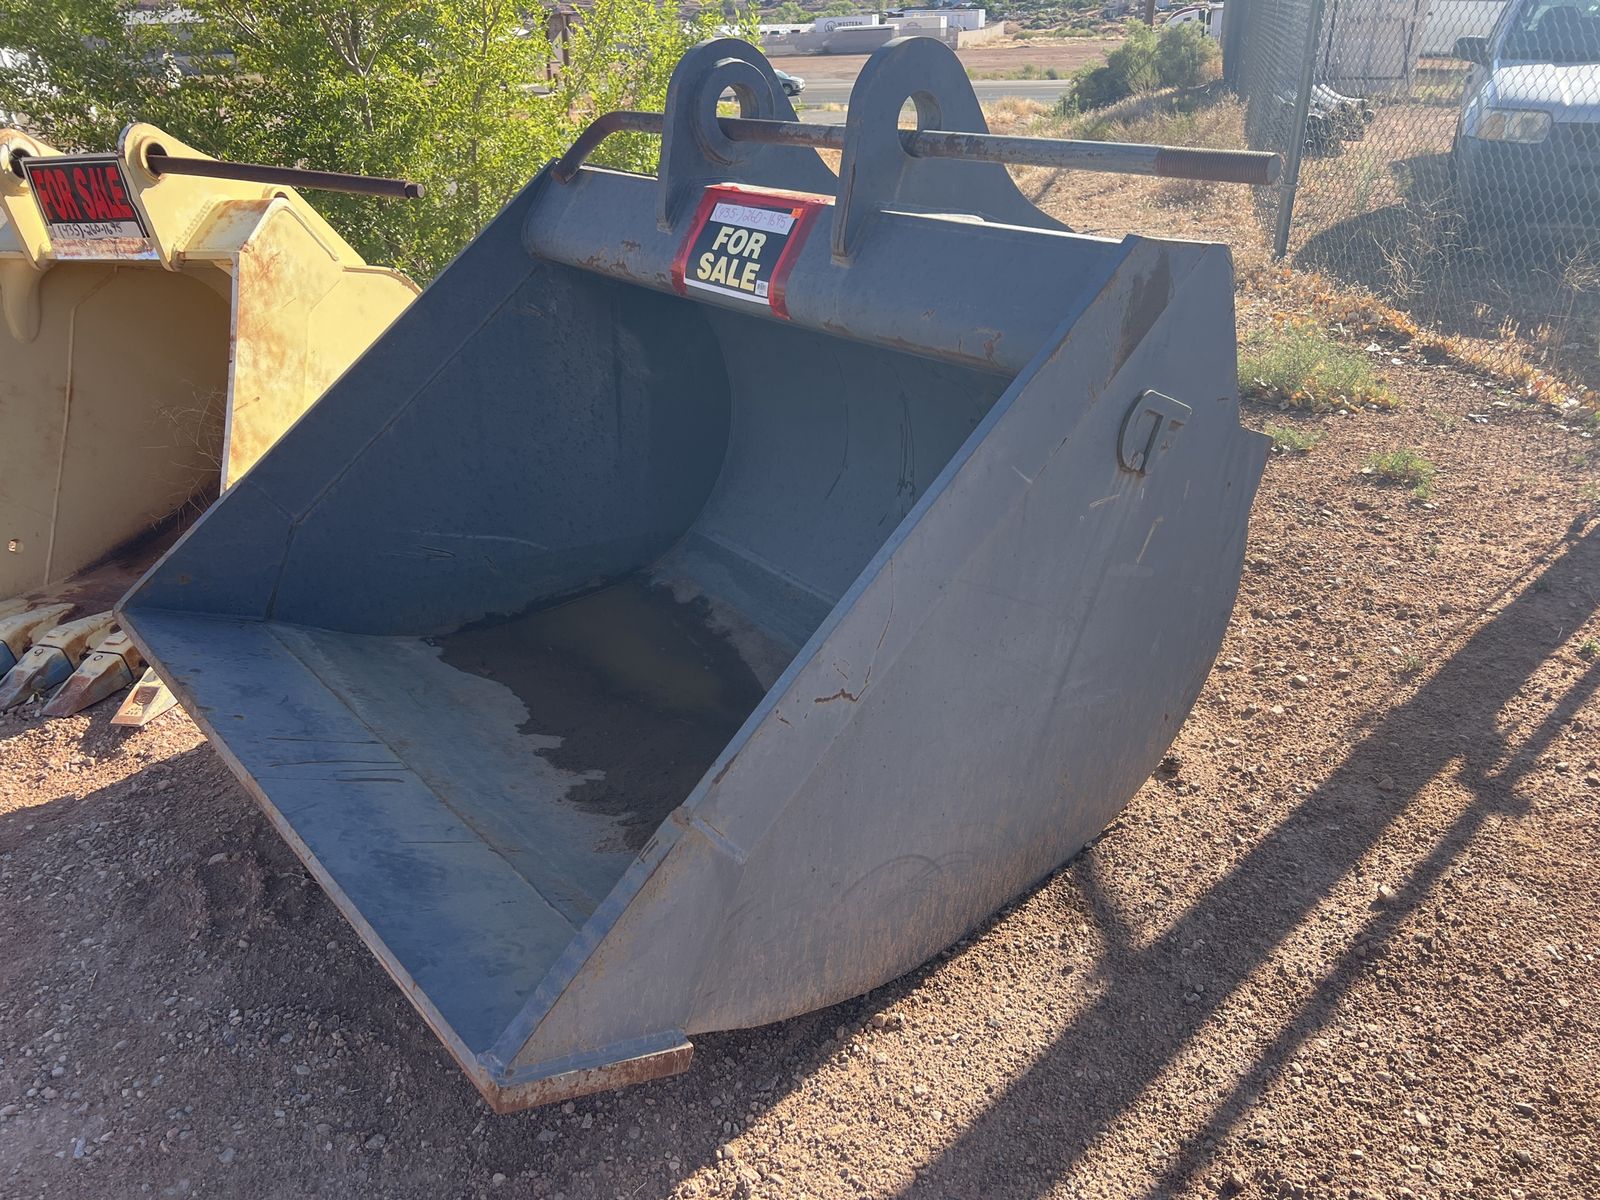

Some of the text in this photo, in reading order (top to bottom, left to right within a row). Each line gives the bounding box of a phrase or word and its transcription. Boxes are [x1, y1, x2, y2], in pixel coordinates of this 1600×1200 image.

[32, 166, 134, 220] FOR SALE
[711, 226, 767, 259] FOR
[697, 252, 761, 291] SALE
